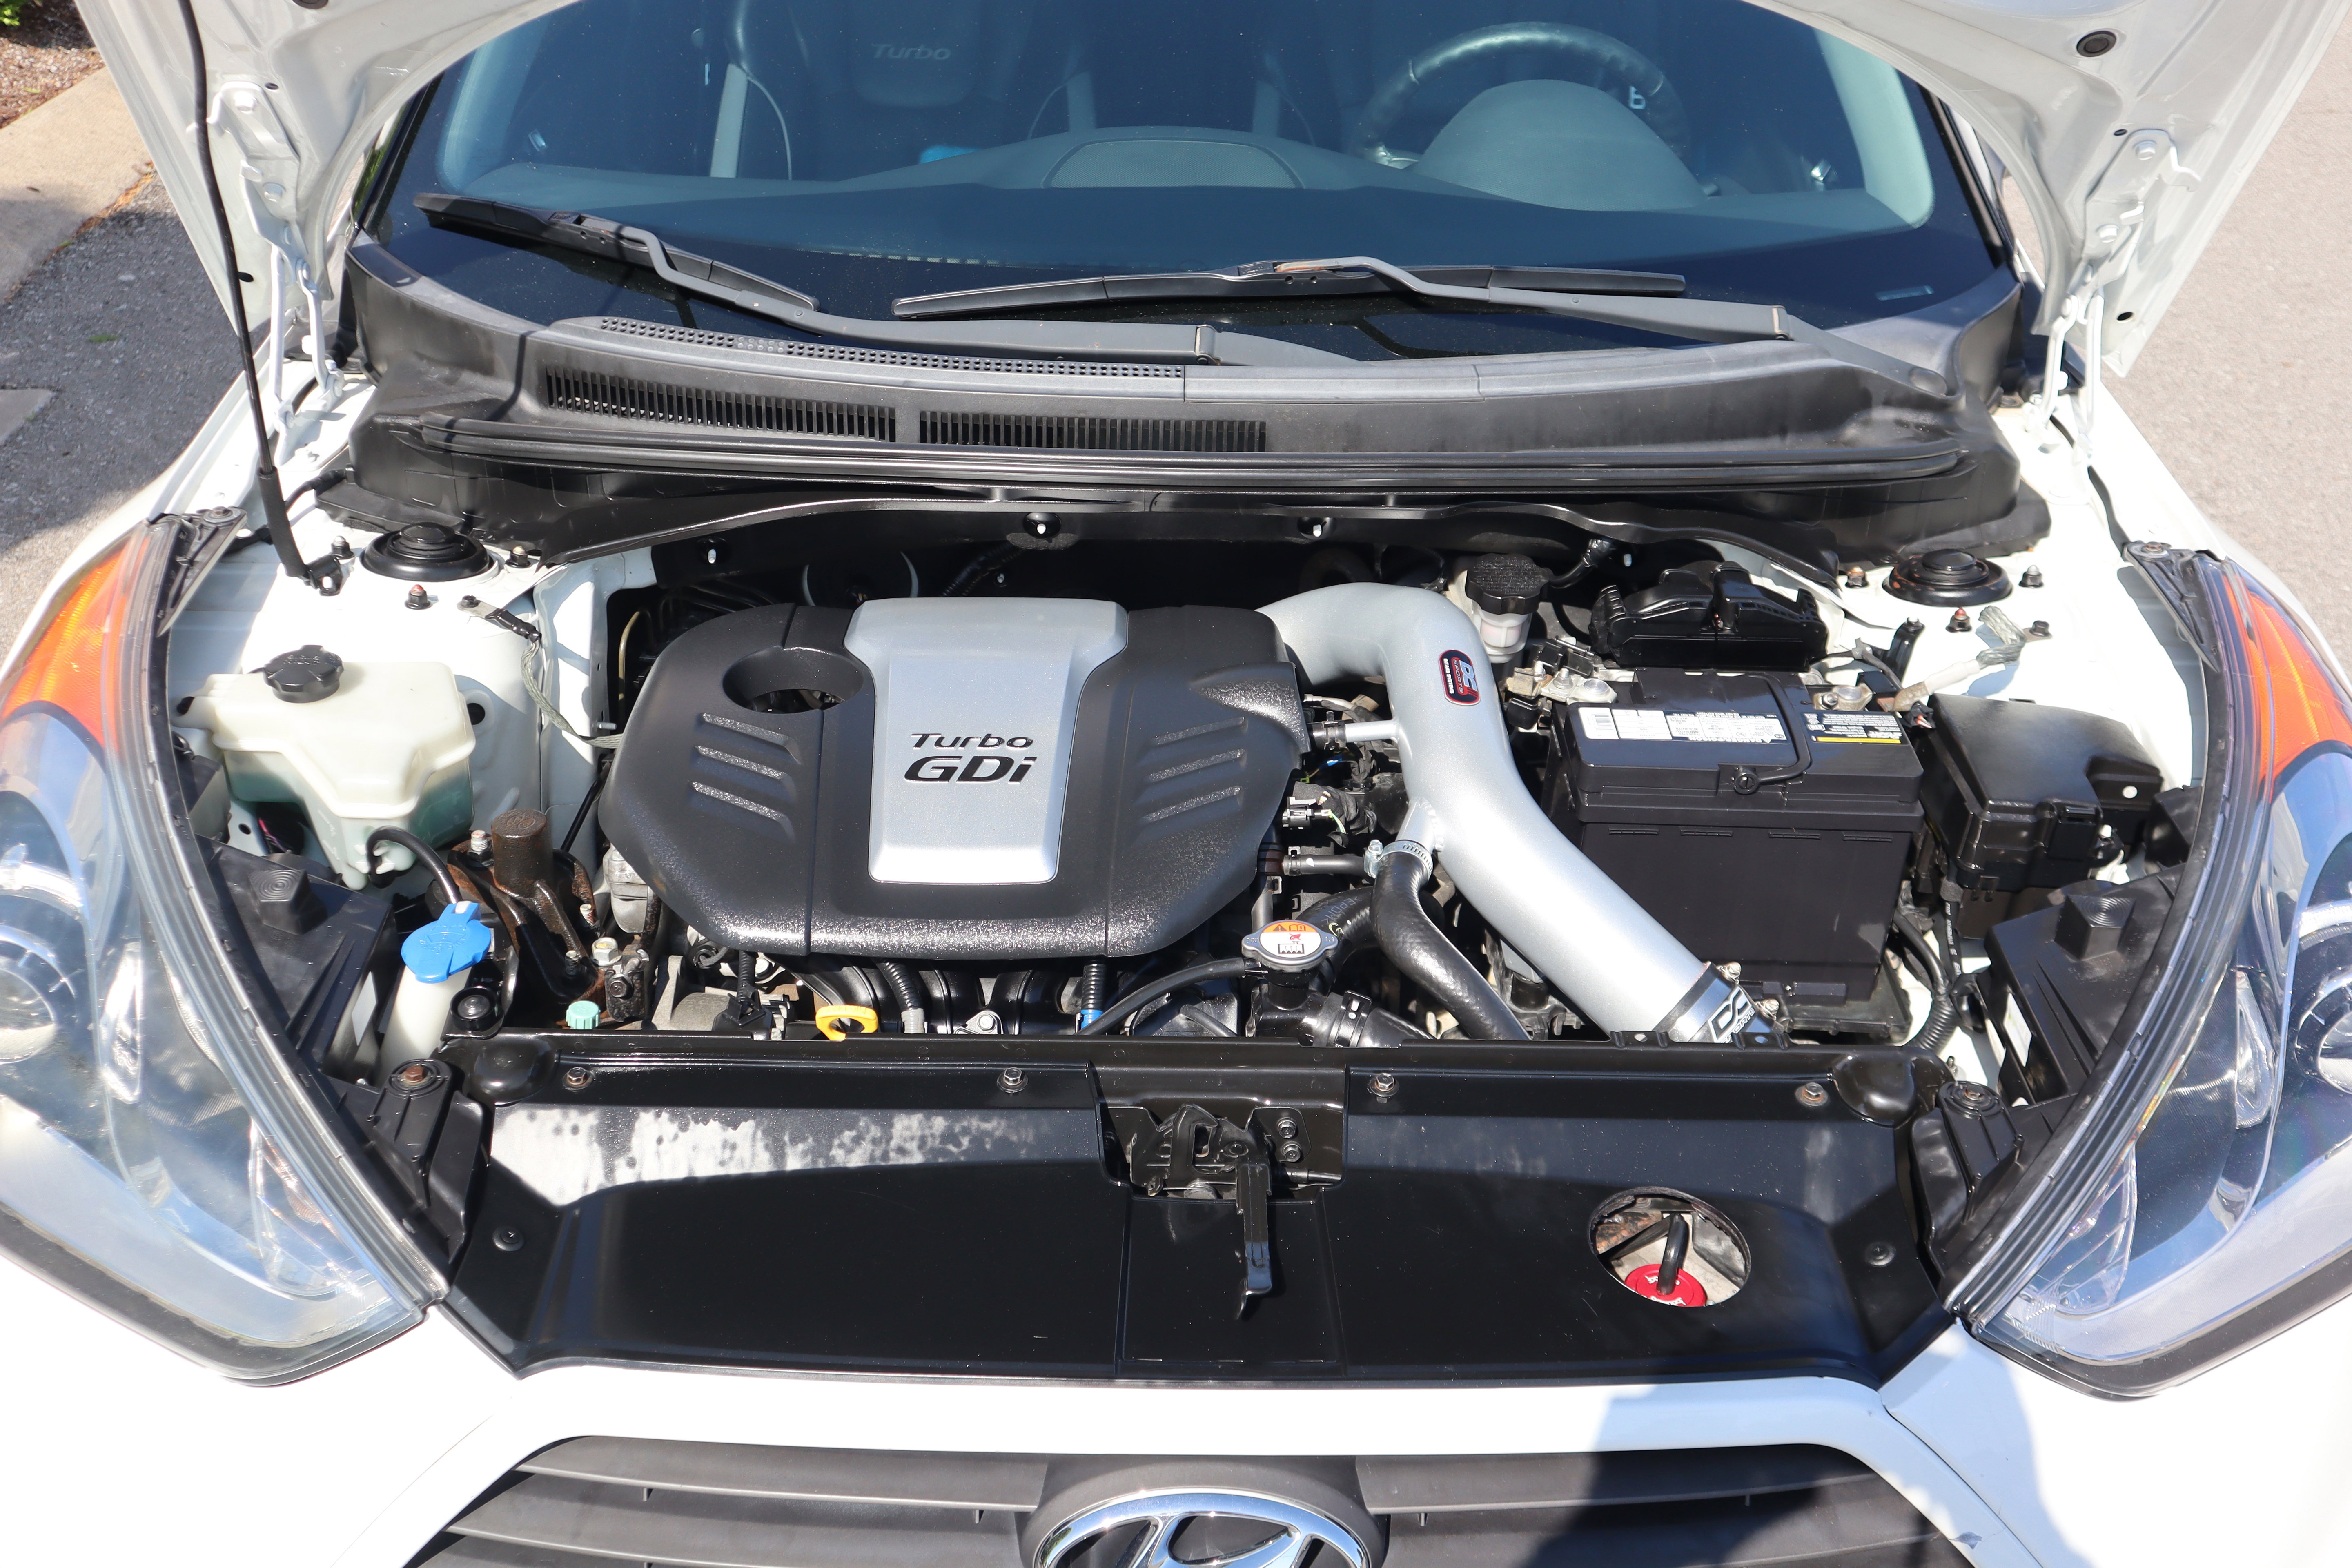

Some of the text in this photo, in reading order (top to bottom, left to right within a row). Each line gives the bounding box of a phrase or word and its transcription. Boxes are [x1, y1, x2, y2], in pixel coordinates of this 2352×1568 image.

[871, 43, 952, 60] Turbo
[1443, 658, 1455, 694] INTAKE SYSTEMS
[1453, 659, 1464, 694] SPORTS
[1459, 659, 1478, 692] DC
[911, 733, 1034, 750] Turbo
[904, 755, 1038, 784] GDi
